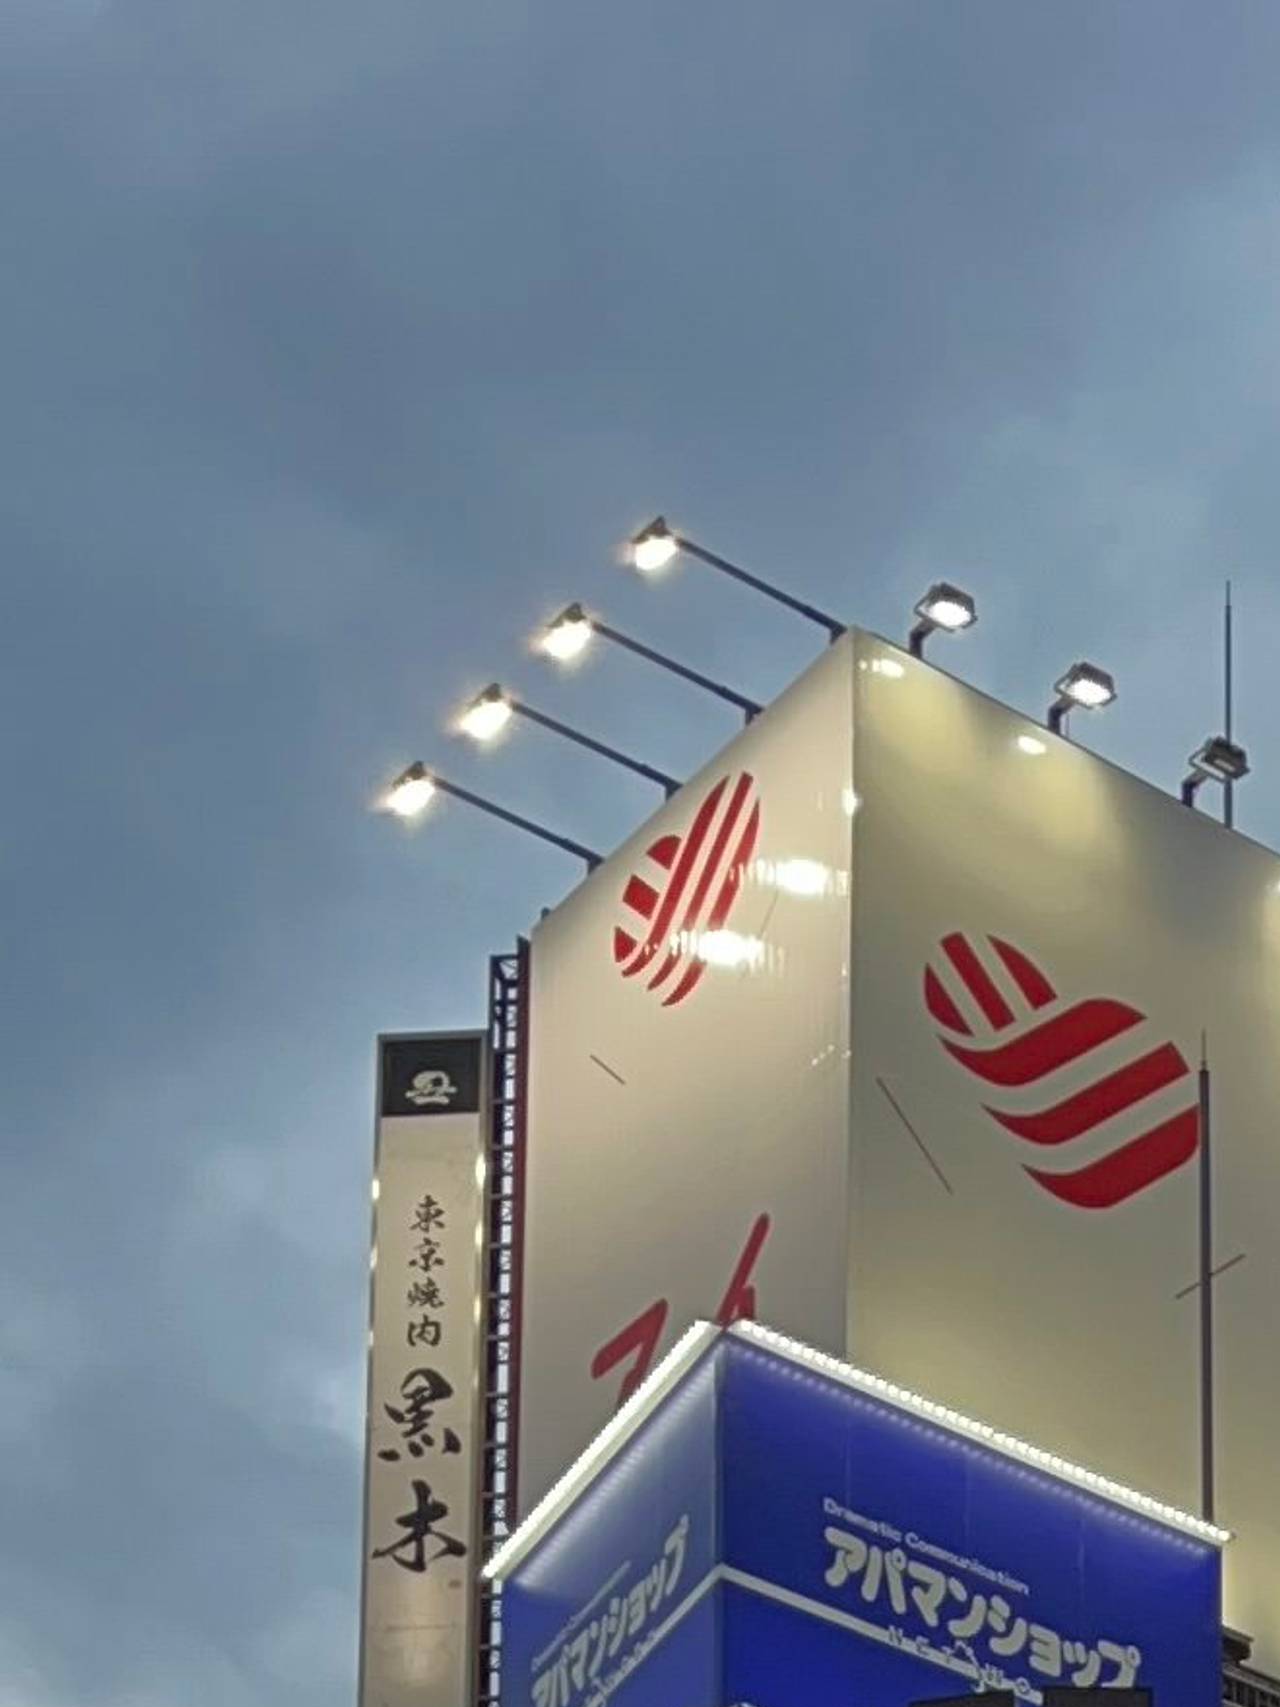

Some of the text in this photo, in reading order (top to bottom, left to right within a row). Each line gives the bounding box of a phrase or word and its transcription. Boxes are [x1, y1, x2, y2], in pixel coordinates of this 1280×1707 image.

[367, 1367, 468, 1573] 黒木
[824, 1526, 1141, 1688] アパマンショップ
